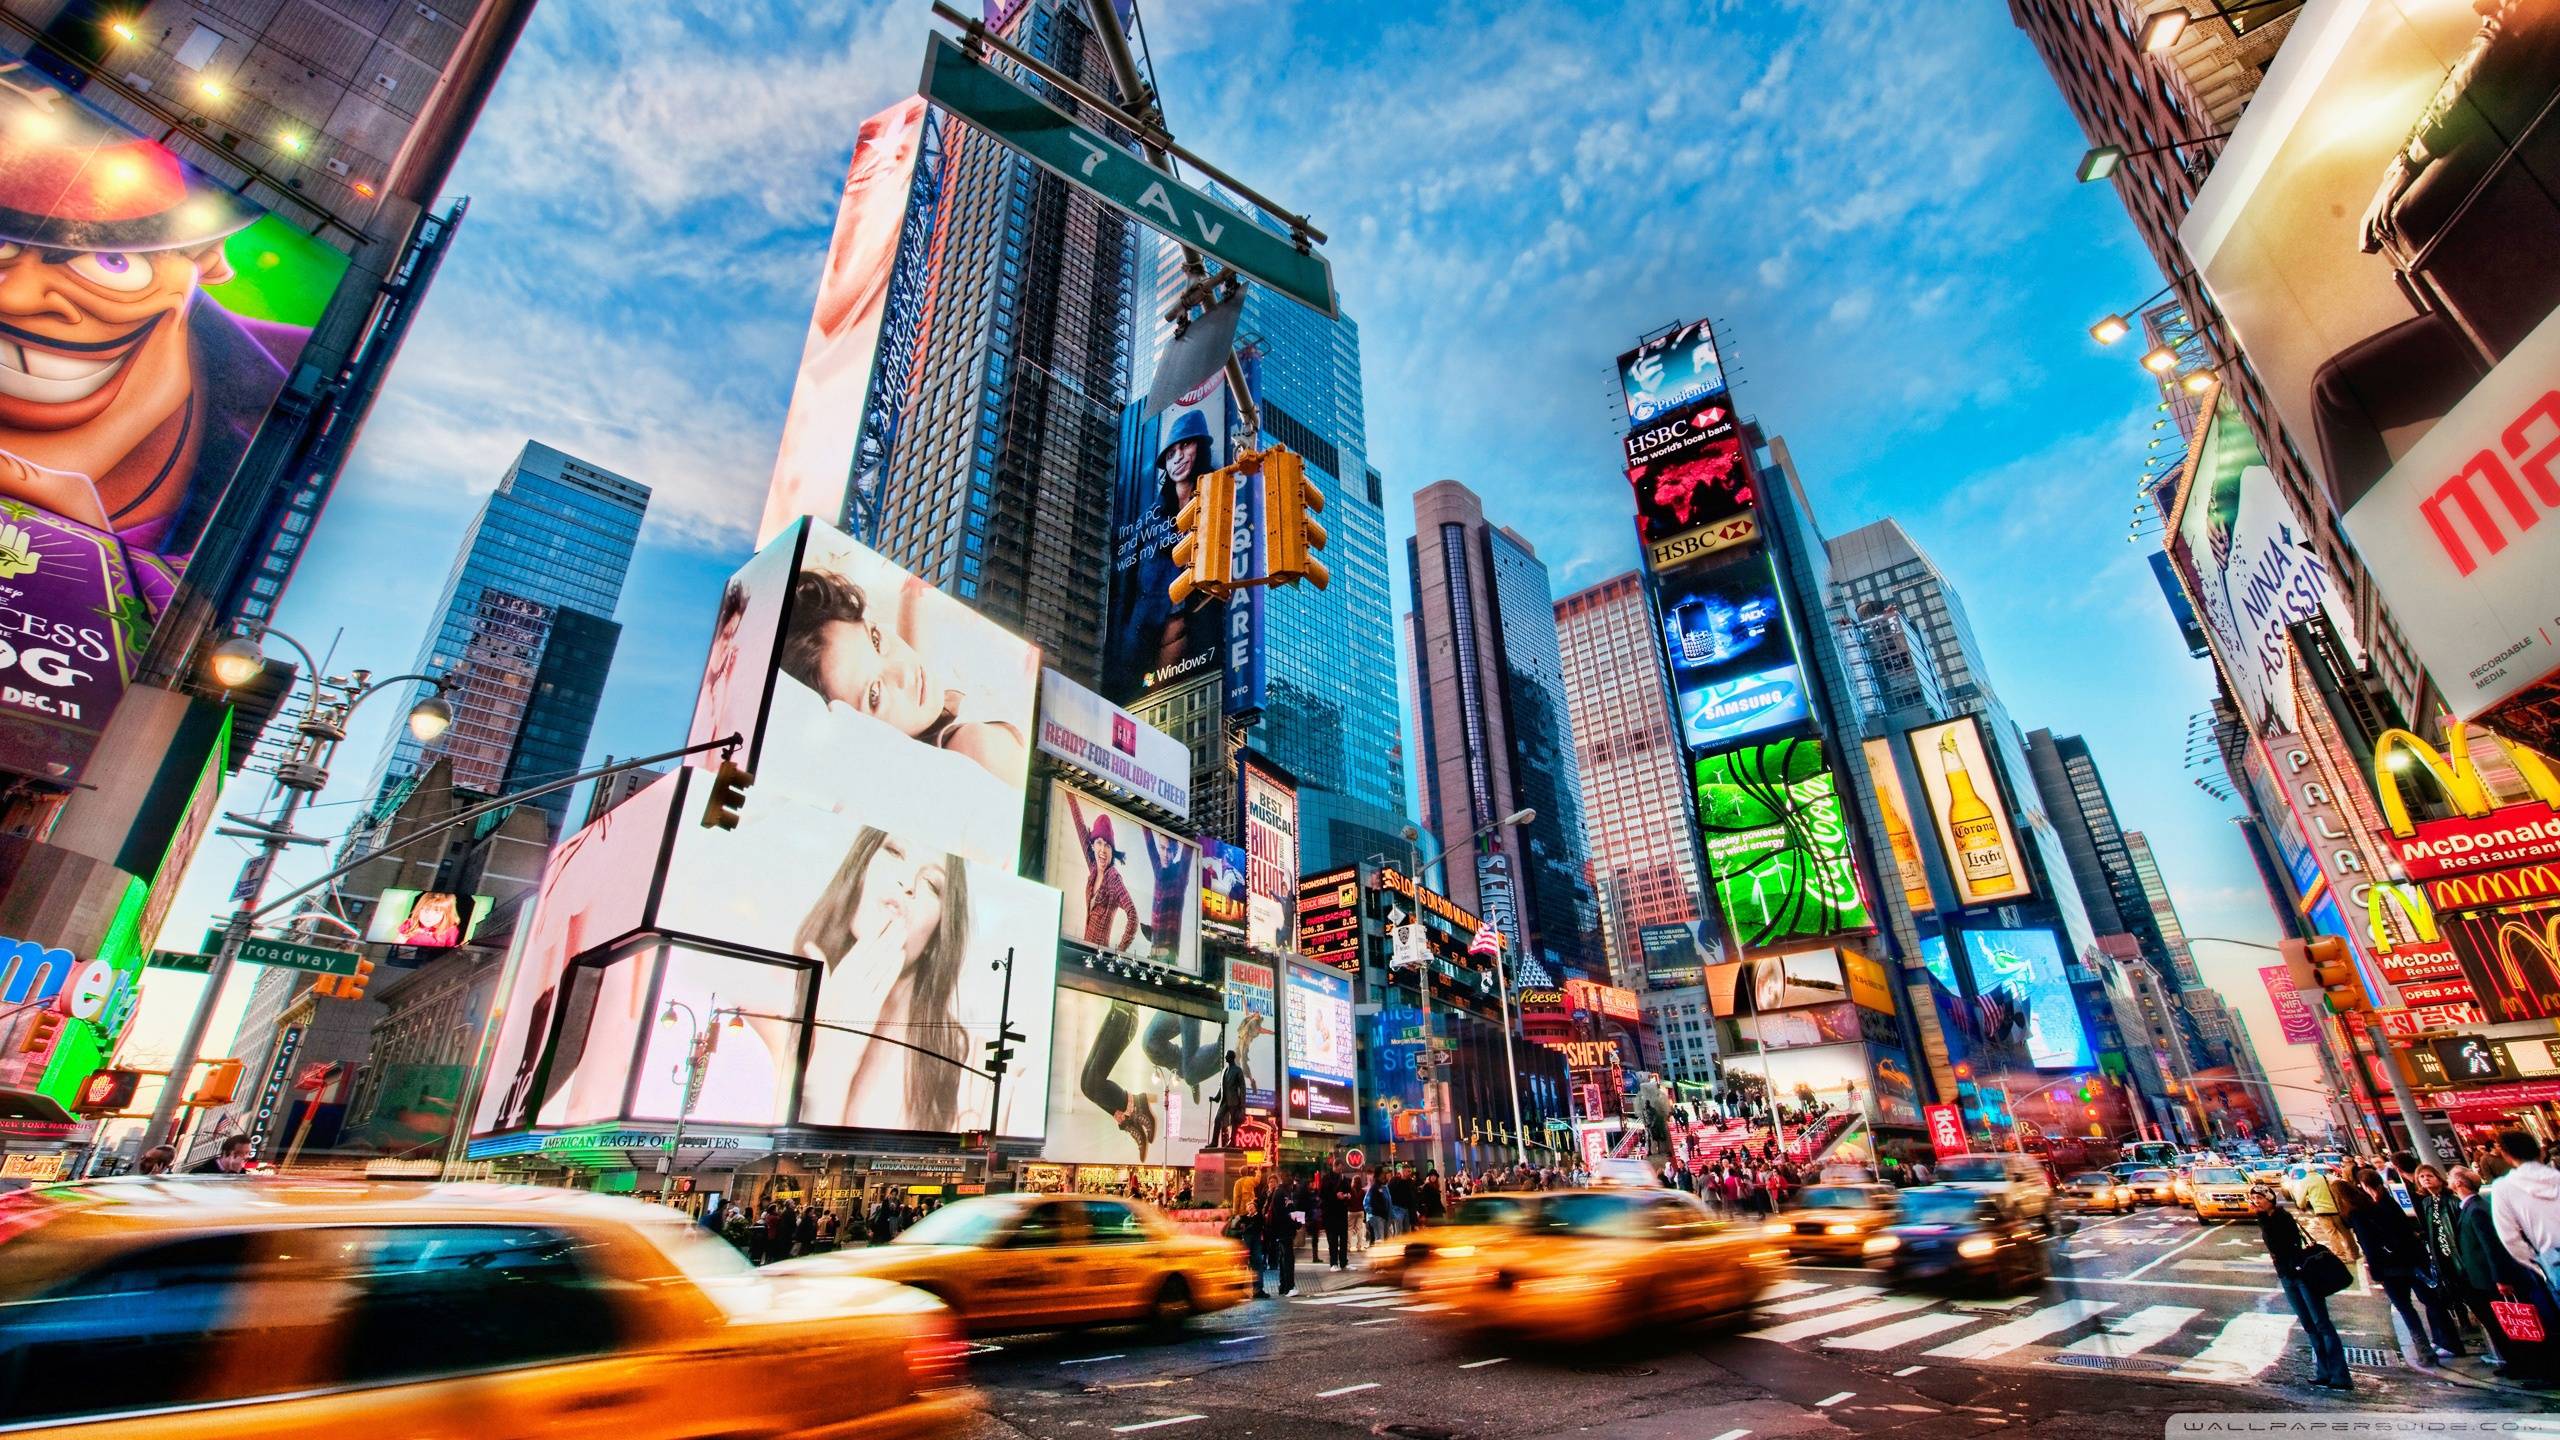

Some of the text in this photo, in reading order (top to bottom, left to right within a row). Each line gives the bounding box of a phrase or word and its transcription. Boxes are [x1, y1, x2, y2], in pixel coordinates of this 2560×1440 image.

[1069, 131, 1108, 178] 7
[1657, 376, 1723, 411] Prudential
[1627, 420, 1689, 456] HSBC
[1630, 423, 1731, 466] The world's local bank
[1119, 504, 1161, 539] I'm a PC
[1117, 538, 1137, 556] and
[1117, 556, 1137, 572] was
[1139, 545, 1157, 562] my
[1654, 530, 1717, 564] HSBC
[1231, 503, 1251, 668] SQUARE
[2242, 536, 2292, 631] NINJA
[1740, 608, 1766, 623] JACK
[1156, 646, 1216, 682] Windows 7
[2469, 636, 2533, 680] RECORDABLE
[1232, 685, 1249, 698] NYC
[2475, 668, 2507, 690] MEDIA
[3, 686, 80, 720] DEC. 11
[1705, 690, 1783, 721] SAMSUNG
[1117, 725, 1131, 745] GAP
[1044, 721, 1186, 809] READY FOR HOLIDAY CHEER
[1259, 791, 1284, 817] BEST
[1250, 801, 1293, 837] MUSICAL
[1955, 822, 1995, 838] Corona
[1251, 820, 1280, 866] BILLY
[1708, 826, 1785, 849] display powered
[1713, 837, 1785, 860] by wind energy
[1966, 850, 2002, 868] Light
[1300, 870, 1355, 891] THOMSON REUTERS
[1300, 901, 1318, 910] STOCK
[246, 944, 336, 971] roadway
[1232, 962, 1272, 989] HEIGHTS
[1228, 994, 1244, 1010] BEST
[1520, 989, 1562, 1003] Reese's
[2275, 991, 2300, 1000] FREE
[2405, 988, 2441, 1000] OPEN
[2445, 986, 2460, 996] 24
[1291, 1089, 1306, 1106] CNN
[22, 1121, 47, 1129] YORK
[1934, 1109, 1956, 1147] tkts
[543, 1136, 595, 1149] AMERICAN
[599, 1136, 646, 1148] EAGLE
